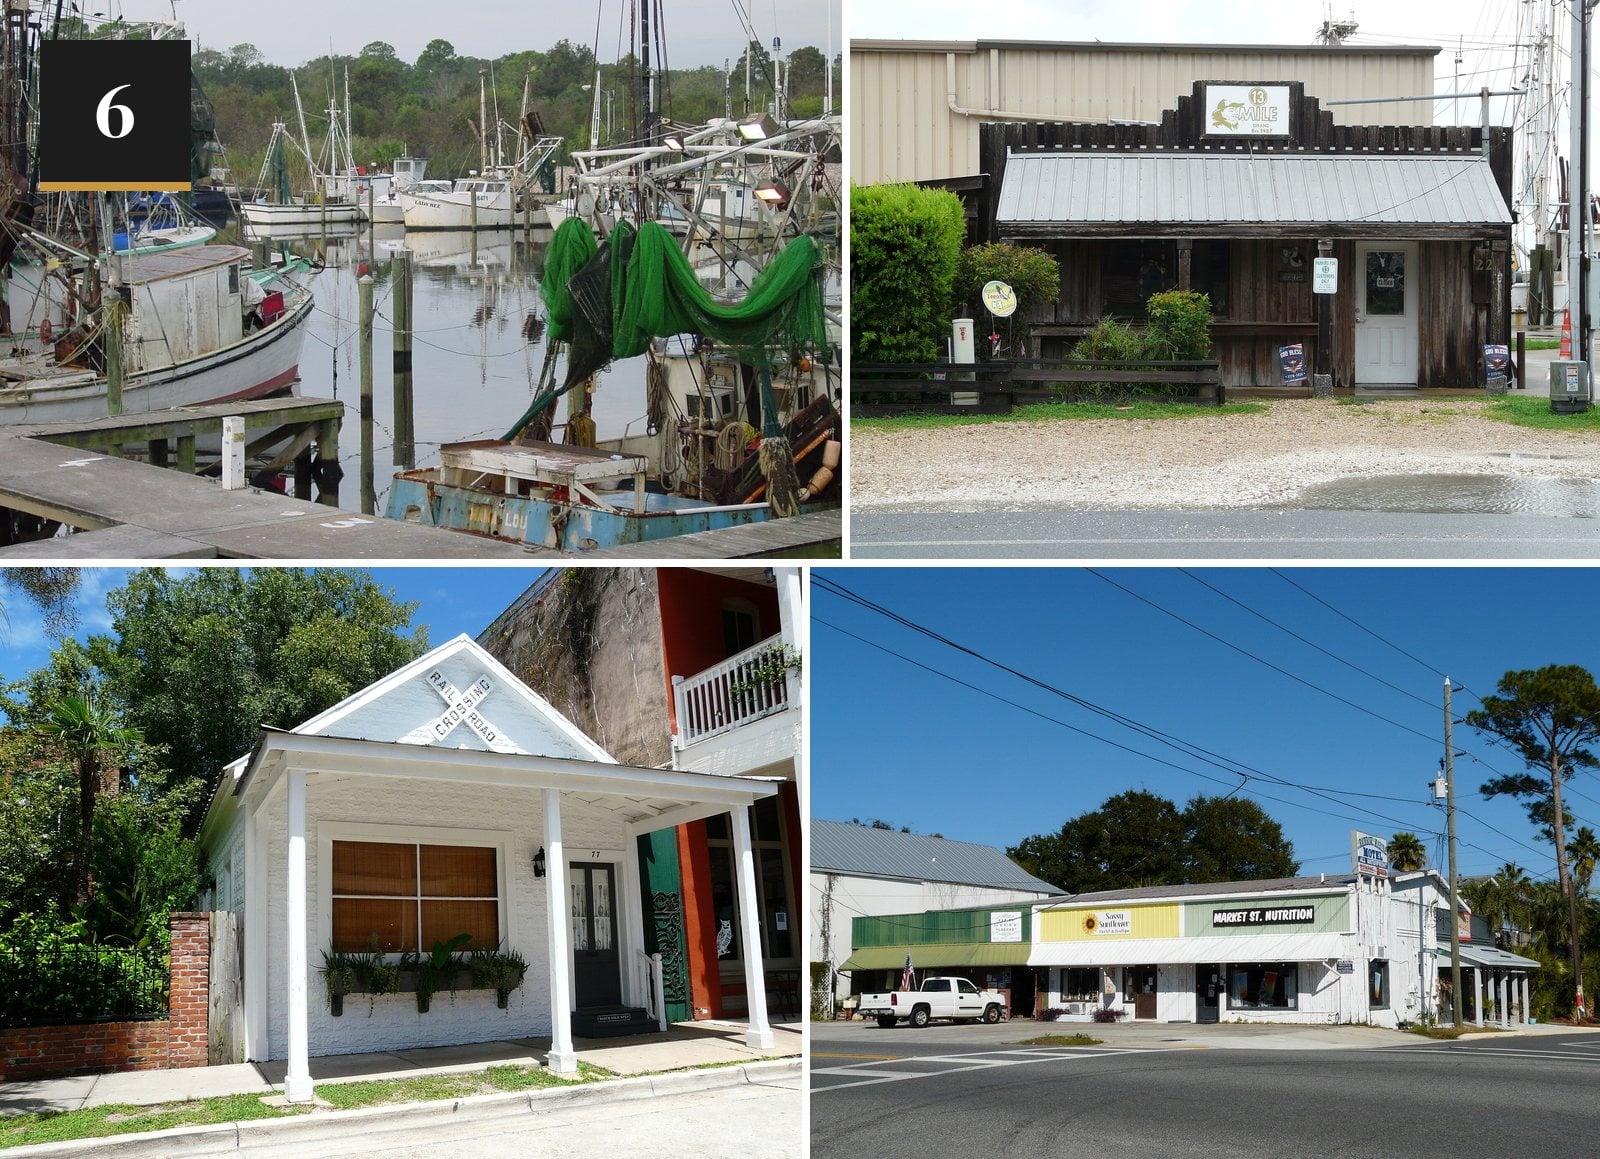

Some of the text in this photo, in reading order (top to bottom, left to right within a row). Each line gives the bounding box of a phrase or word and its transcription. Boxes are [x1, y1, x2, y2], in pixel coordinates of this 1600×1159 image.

[1252, 90, 1265, 104] 13
[1238, 106, 1278, 121] MILE
[504, 512, 528, 530] LOU
[430, 671, 496, 742] RAIL ROAD
[435, 679, 490, 736] CROSSING
[591, 850, 601, 858] 77
[1363, 847, 1383, 861] MOTEL
[1105, 912, 1124, 921] Sassy
[1213, 908, 1313, 923] MARKET ST. NUTRITION
[1099, 920, 1130, 928] Sunflower
